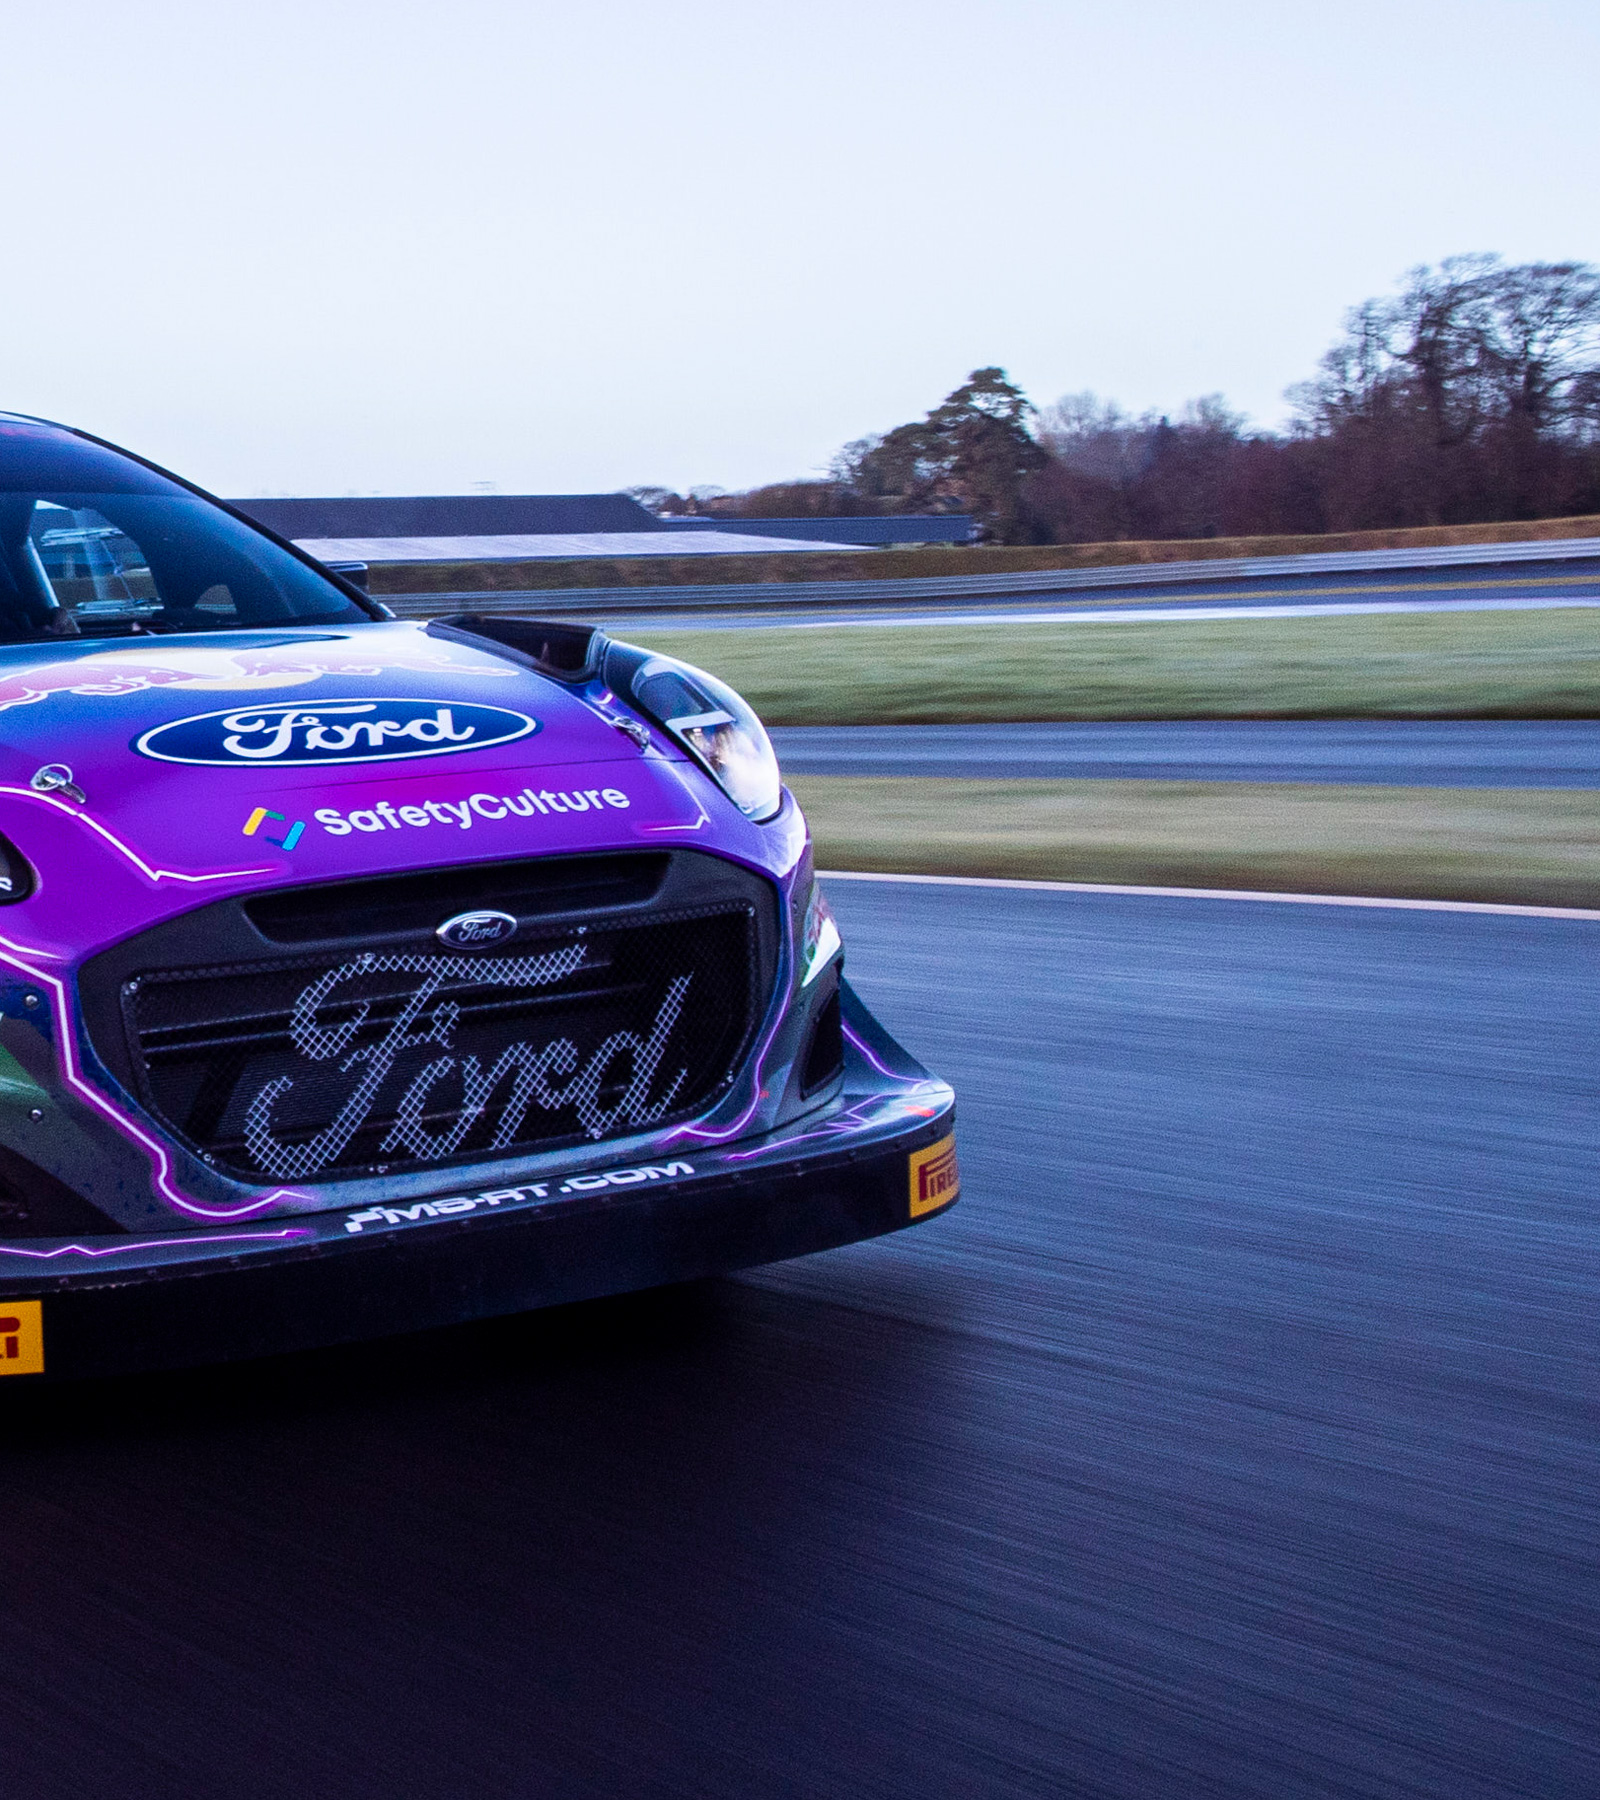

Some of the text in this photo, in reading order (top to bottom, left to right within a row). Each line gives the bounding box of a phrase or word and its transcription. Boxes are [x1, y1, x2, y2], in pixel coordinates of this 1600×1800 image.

[222, 702, 475, 758] Ford
[314, 781, 631, 838] SafetyCulture
[458, 917, 503, 942] Ford
[243, 943, 694, 1180] Ford
[918, 1145, 958, 1203] PIRE
